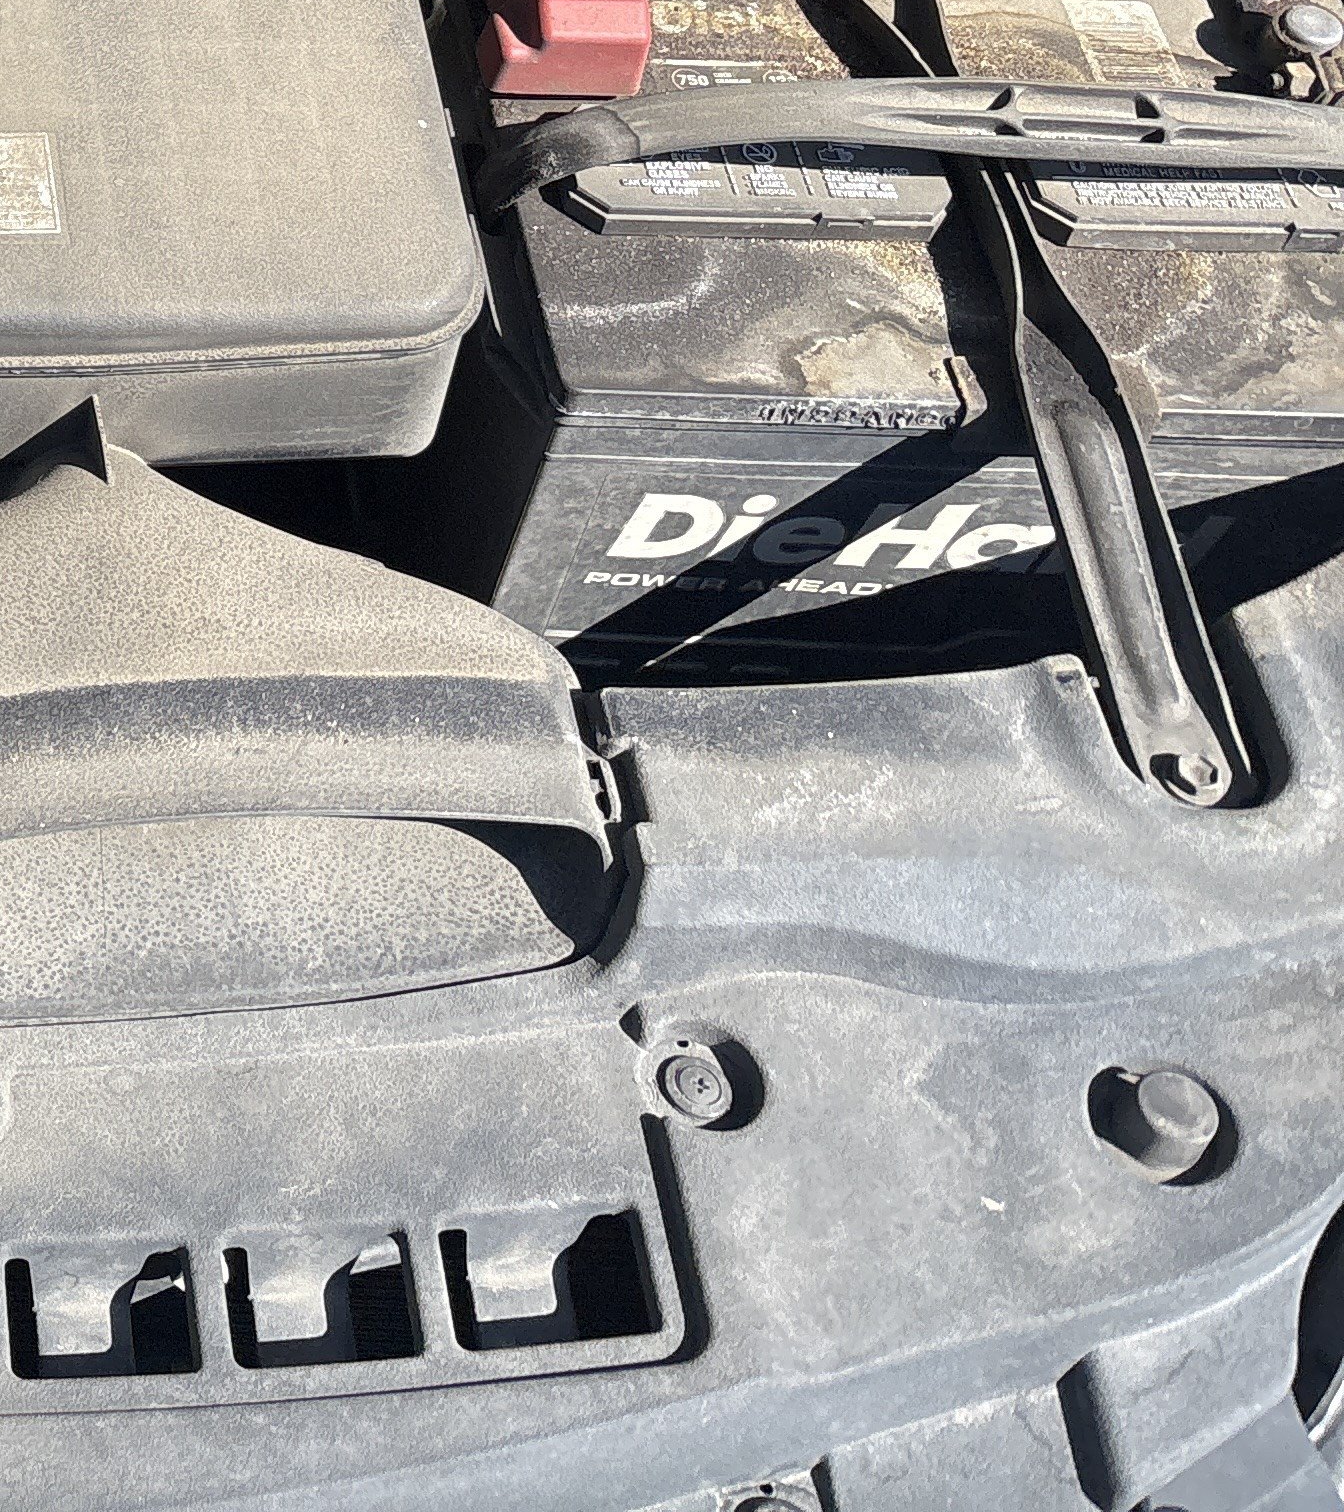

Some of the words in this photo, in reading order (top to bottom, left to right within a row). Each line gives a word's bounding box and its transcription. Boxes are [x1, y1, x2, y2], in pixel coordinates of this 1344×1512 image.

[676, 74, 710, 86] 750
[645, 161, 711, 171] EXPLOSIVE
[1103, 168, 1156, 177] MEDICAL
[1158, 169, 1190, 178] HELP
[1194, 170, 1223, 179] FAST
[584, 572, 728, 591] POWER
[740, 578, 883, 596] AHEAD
